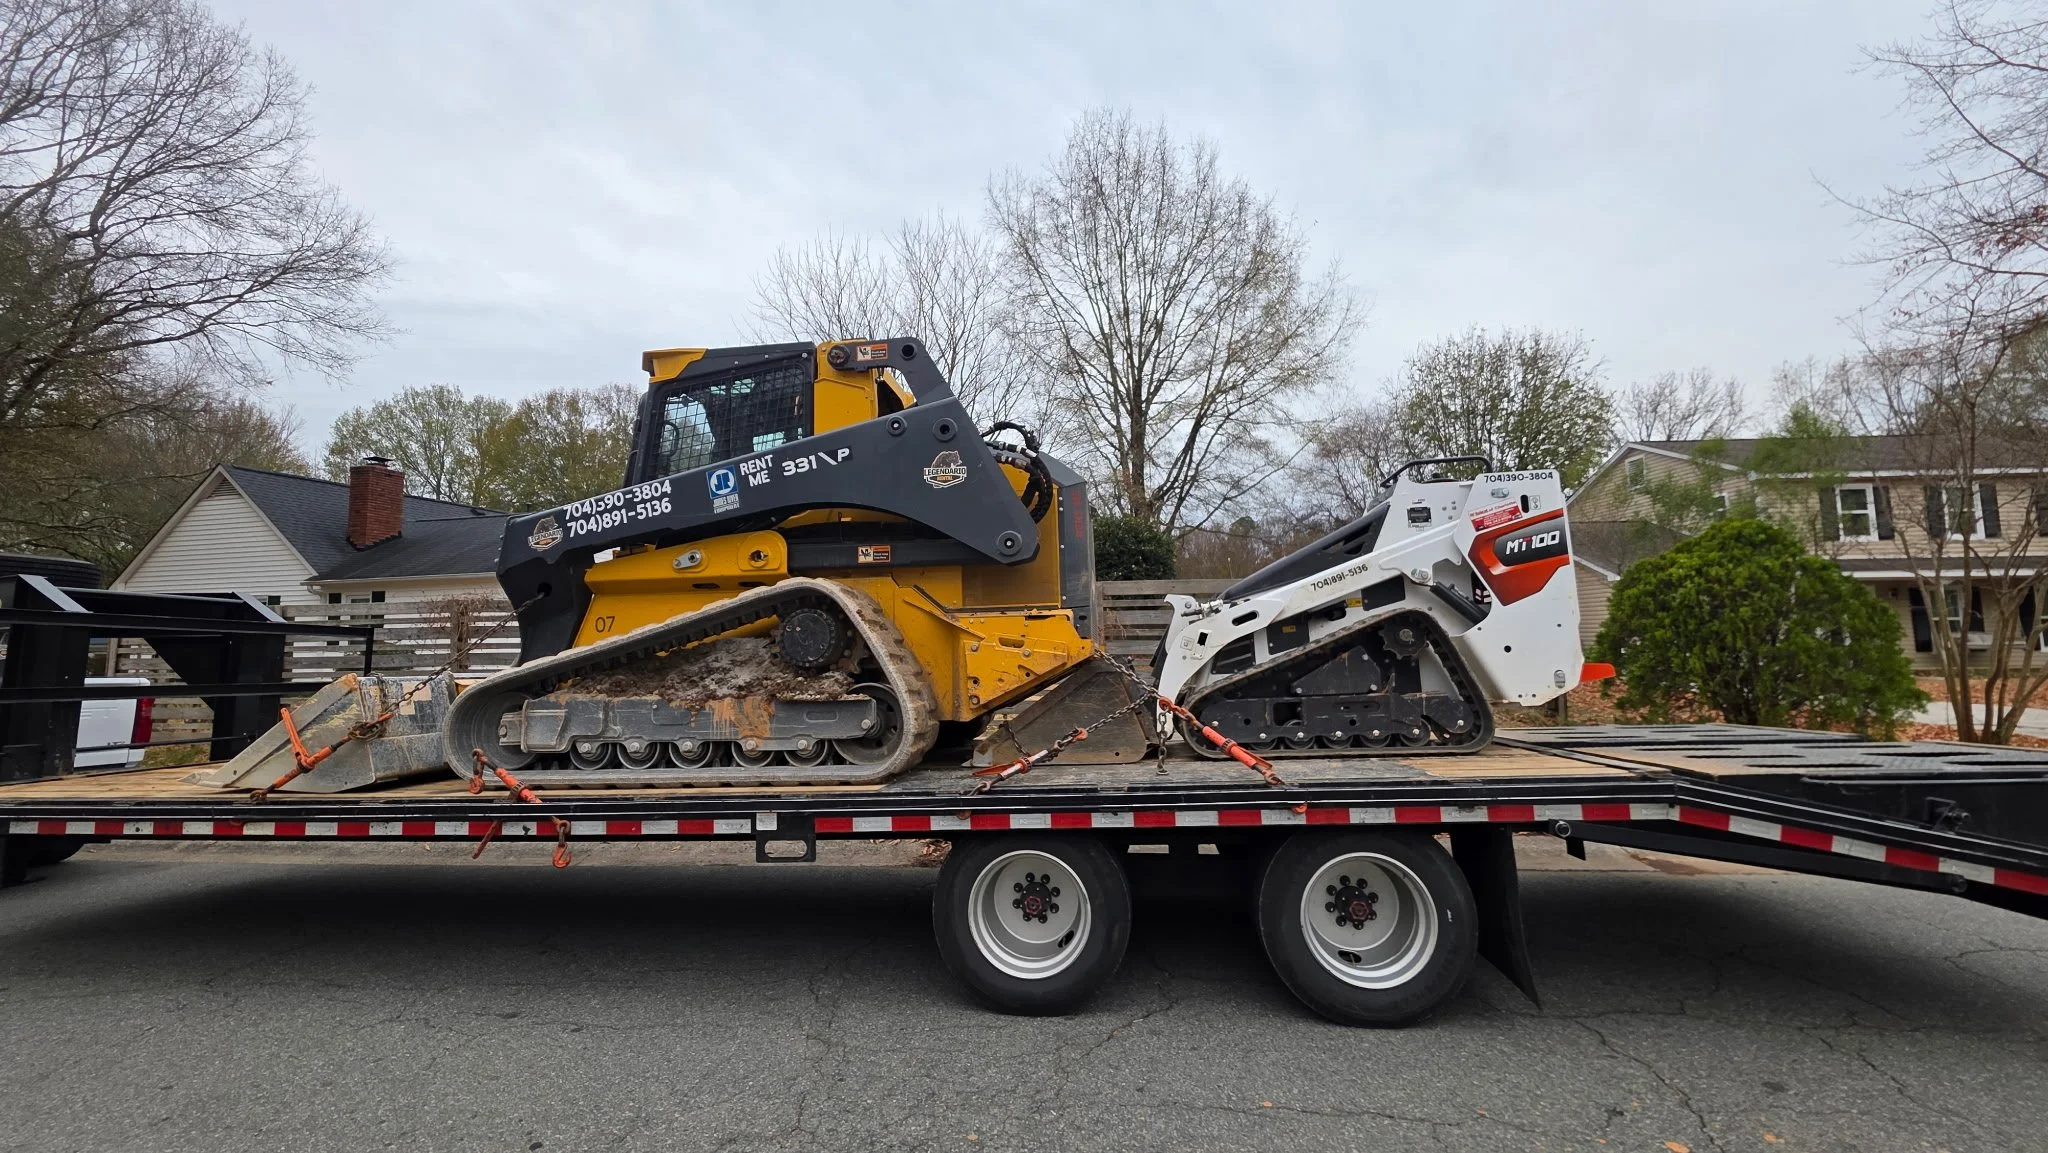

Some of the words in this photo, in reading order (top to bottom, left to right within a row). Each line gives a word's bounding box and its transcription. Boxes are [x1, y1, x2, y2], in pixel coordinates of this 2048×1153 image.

[739, 454, 773, 476] RENT
[925, 467, 966, 476] LEGENDARIO
[748, 470, 771, 487] ME
[1484, 472, 1553, 483] 704)390-3804
[567, 498, 672, 537] 704)891-5136
[1506, 530, 1560, 554] MT100
[1311, 564, 1368, 591] 704)891-5136
[595, 616, 615, 633] 07
